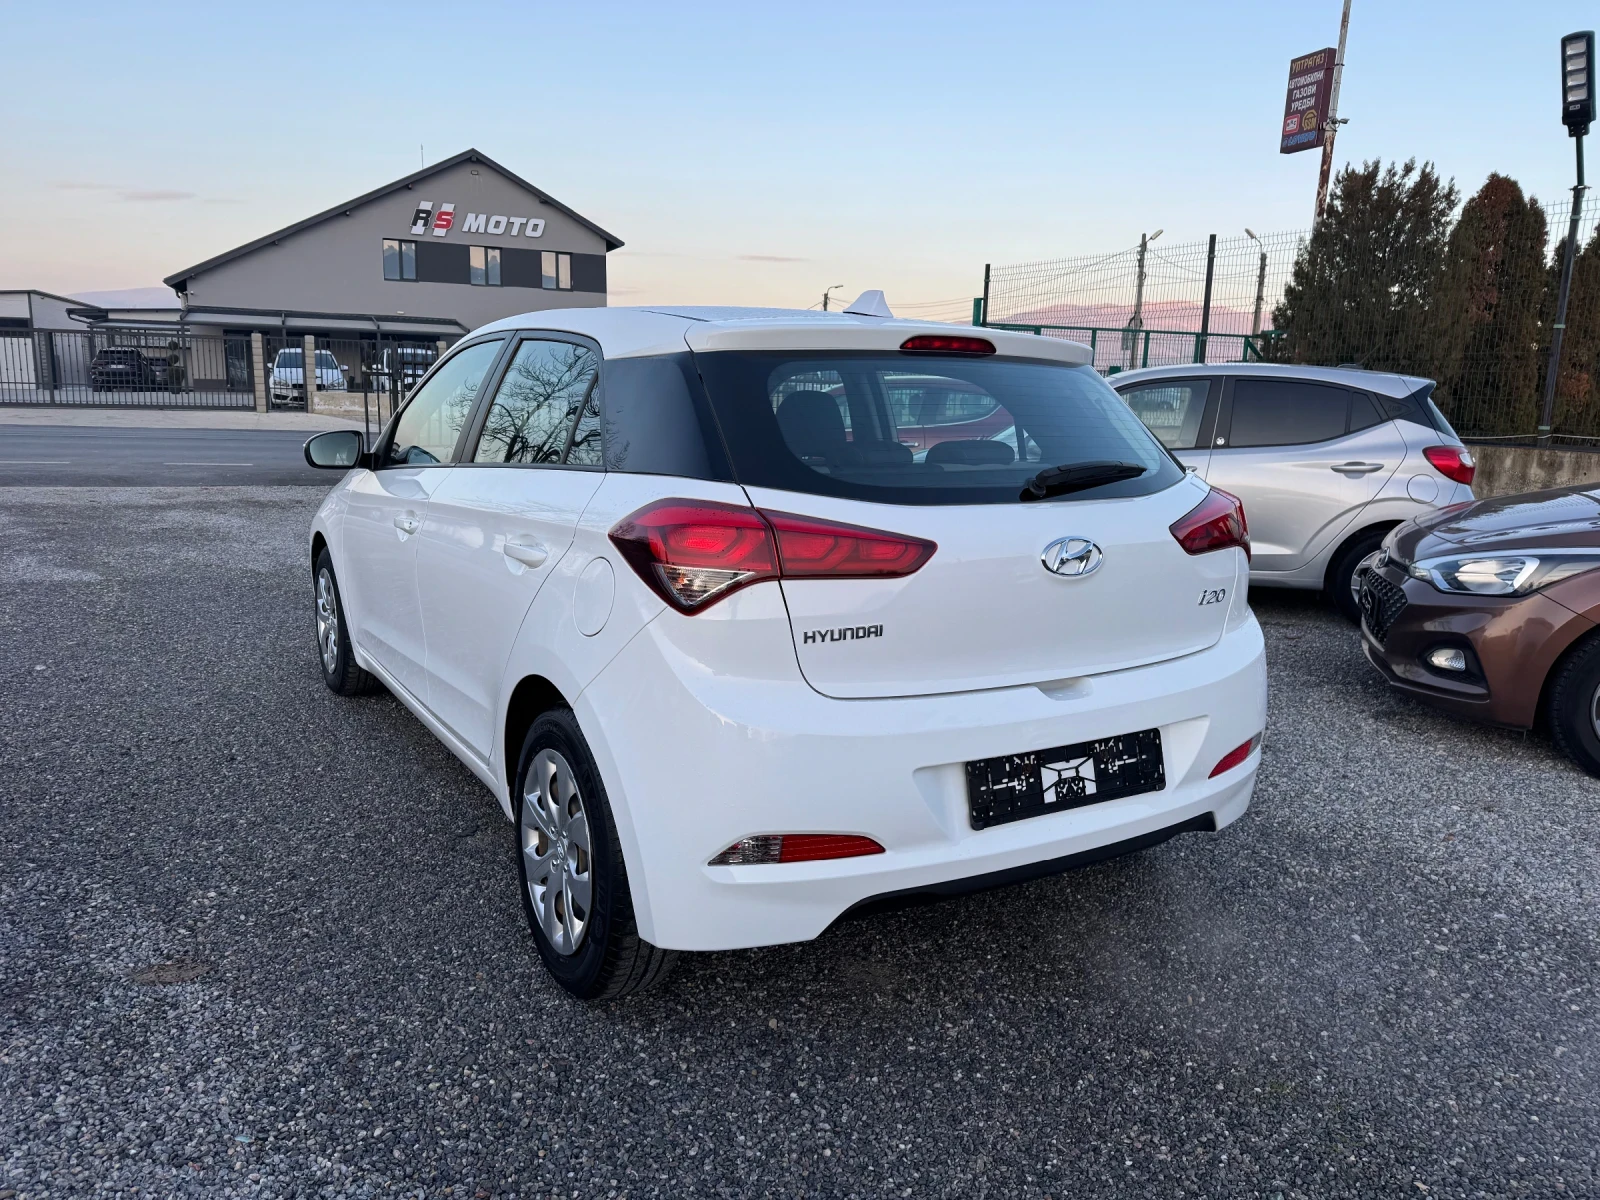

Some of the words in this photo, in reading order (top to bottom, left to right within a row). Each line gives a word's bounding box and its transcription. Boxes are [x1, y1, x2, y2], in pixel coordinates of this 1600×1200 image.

[1292, 84, 1317, 100] ГАЗОВИ
[1290, 96, 1316, 112] УРЕДБИ
[410, 207, 456, 231] RS
[461, 212, 547, 239] MOTO
[1197, 587, 1227, 607] i20
[803, 623, 884, 645] HYUNDAI
